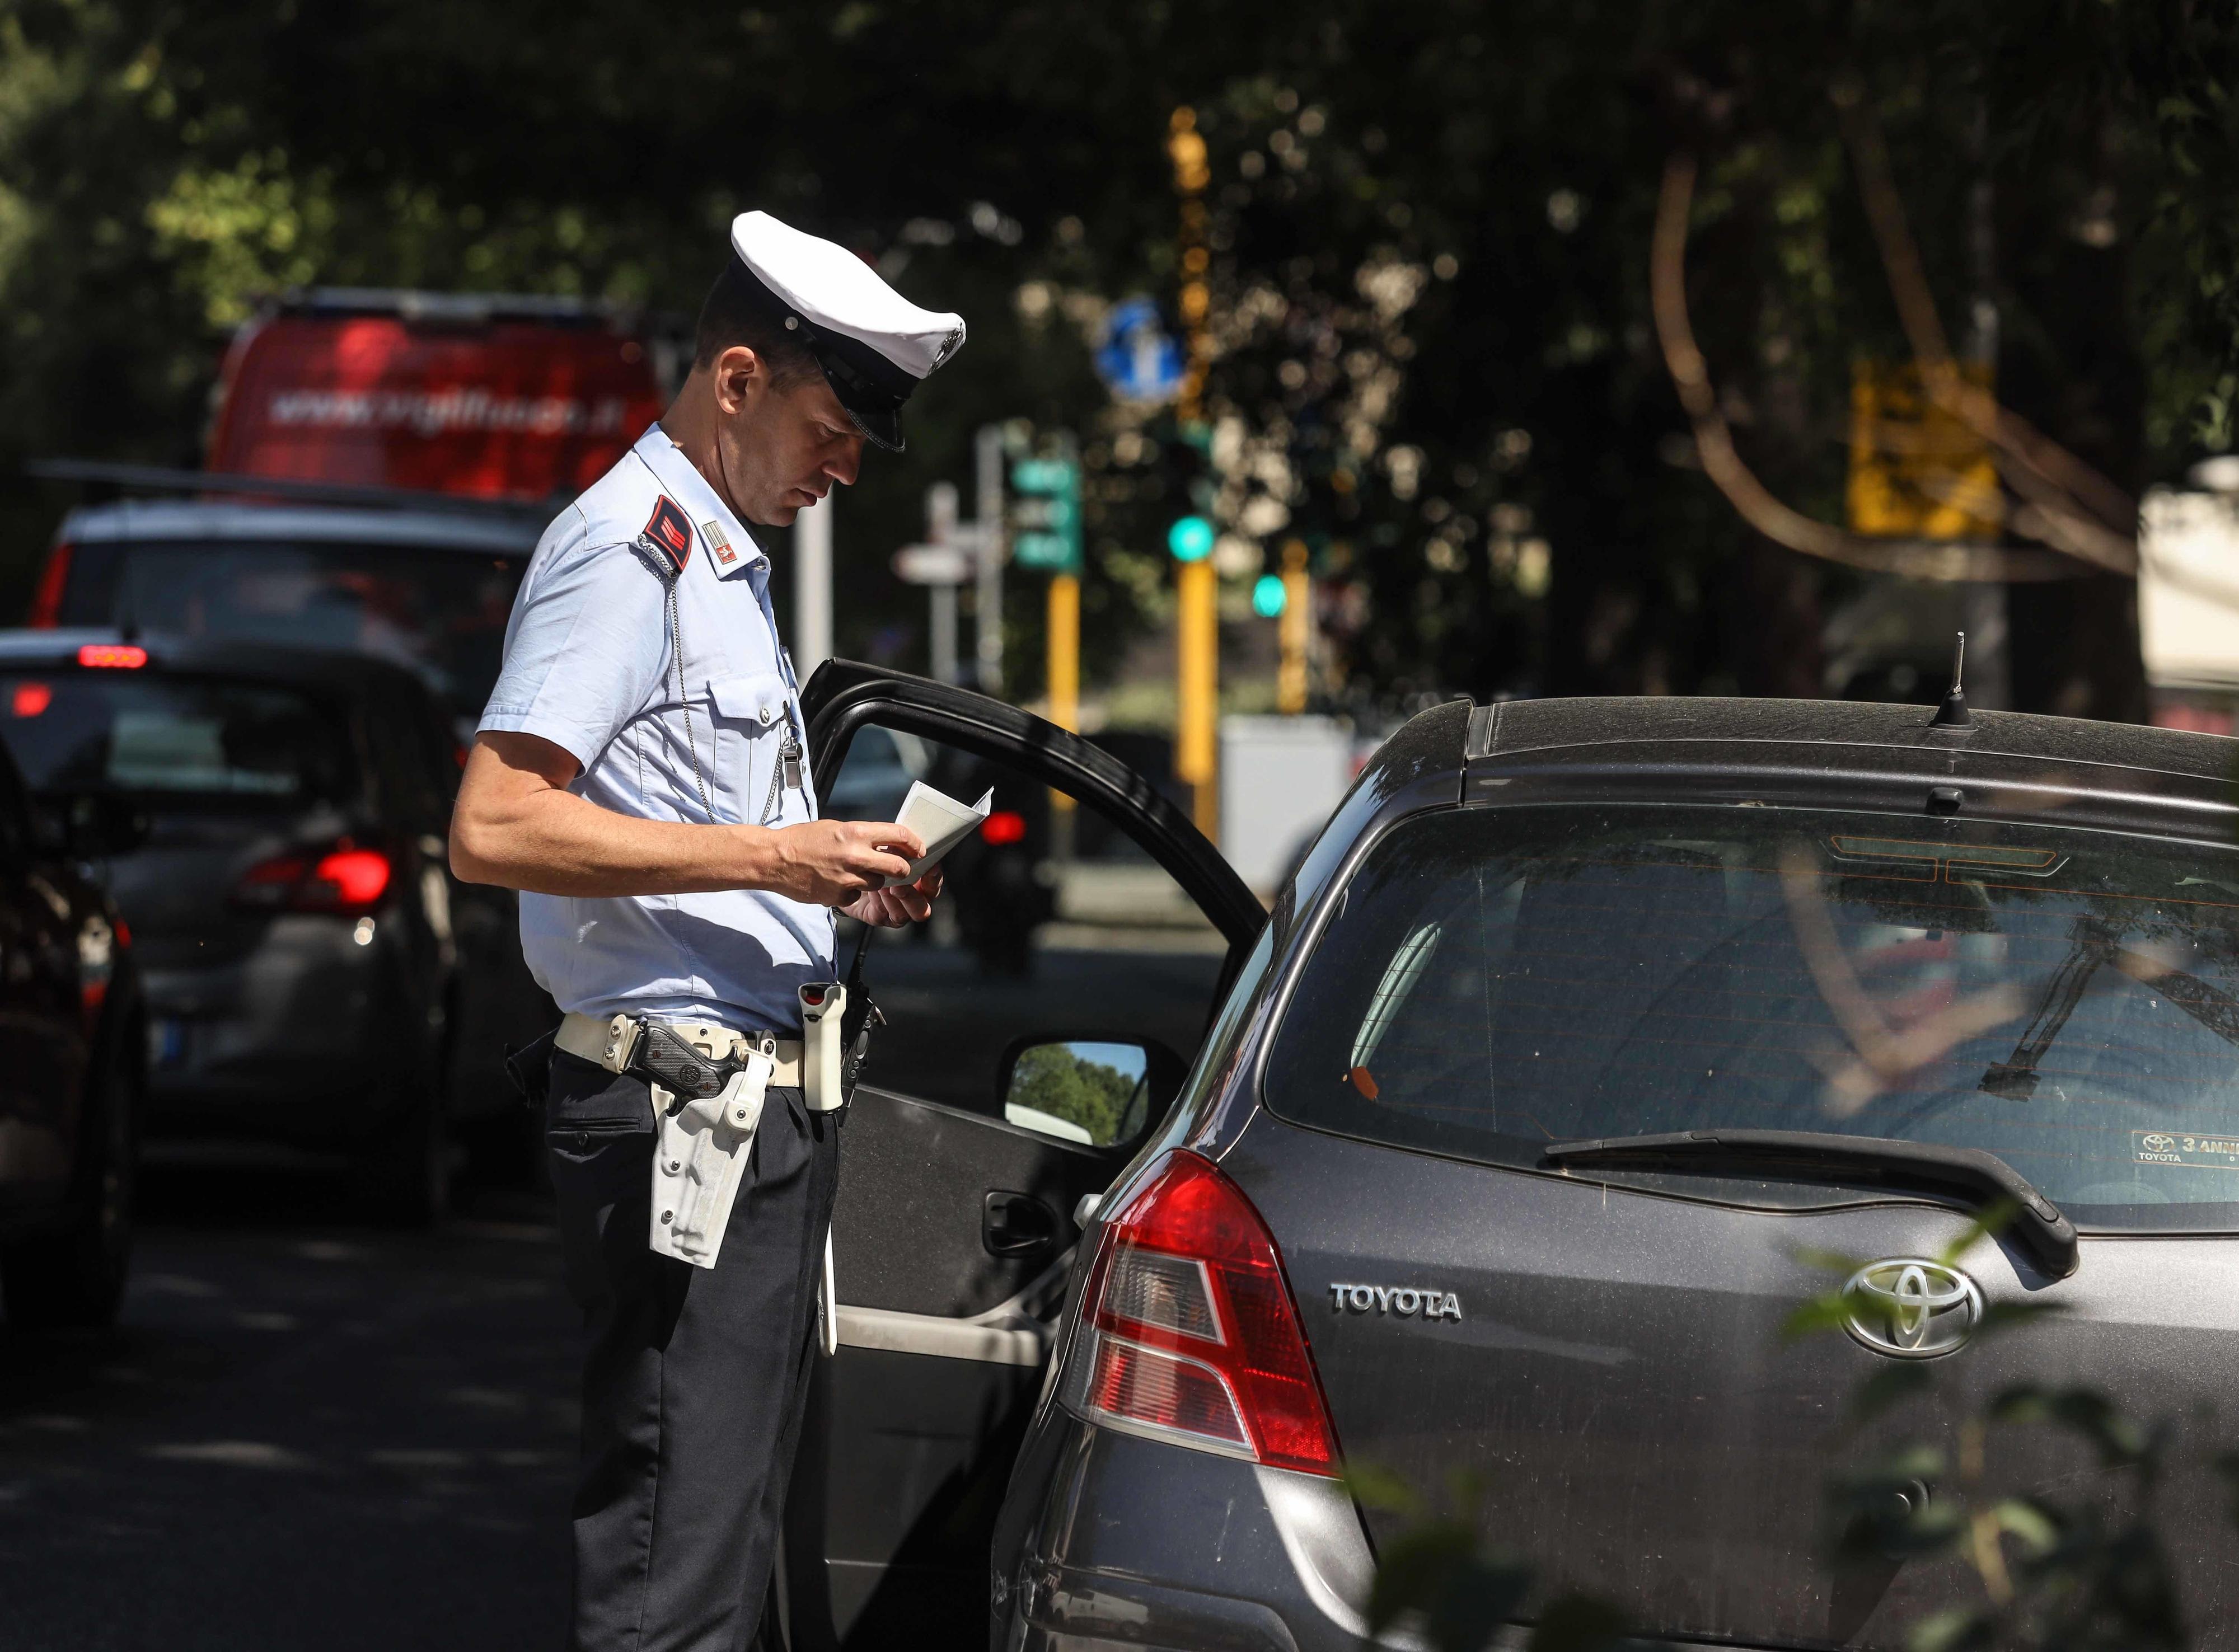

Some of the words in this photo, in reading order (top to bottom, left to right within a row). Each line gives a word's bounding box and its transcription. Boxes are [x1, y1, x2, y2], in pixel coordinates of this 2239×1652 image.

[2183, 1137, 2195, 1152] 3
[2139, 1152, 2181, 1162] TOYOTA
[1330, 1284, 1462, 1320] TOYOTA
